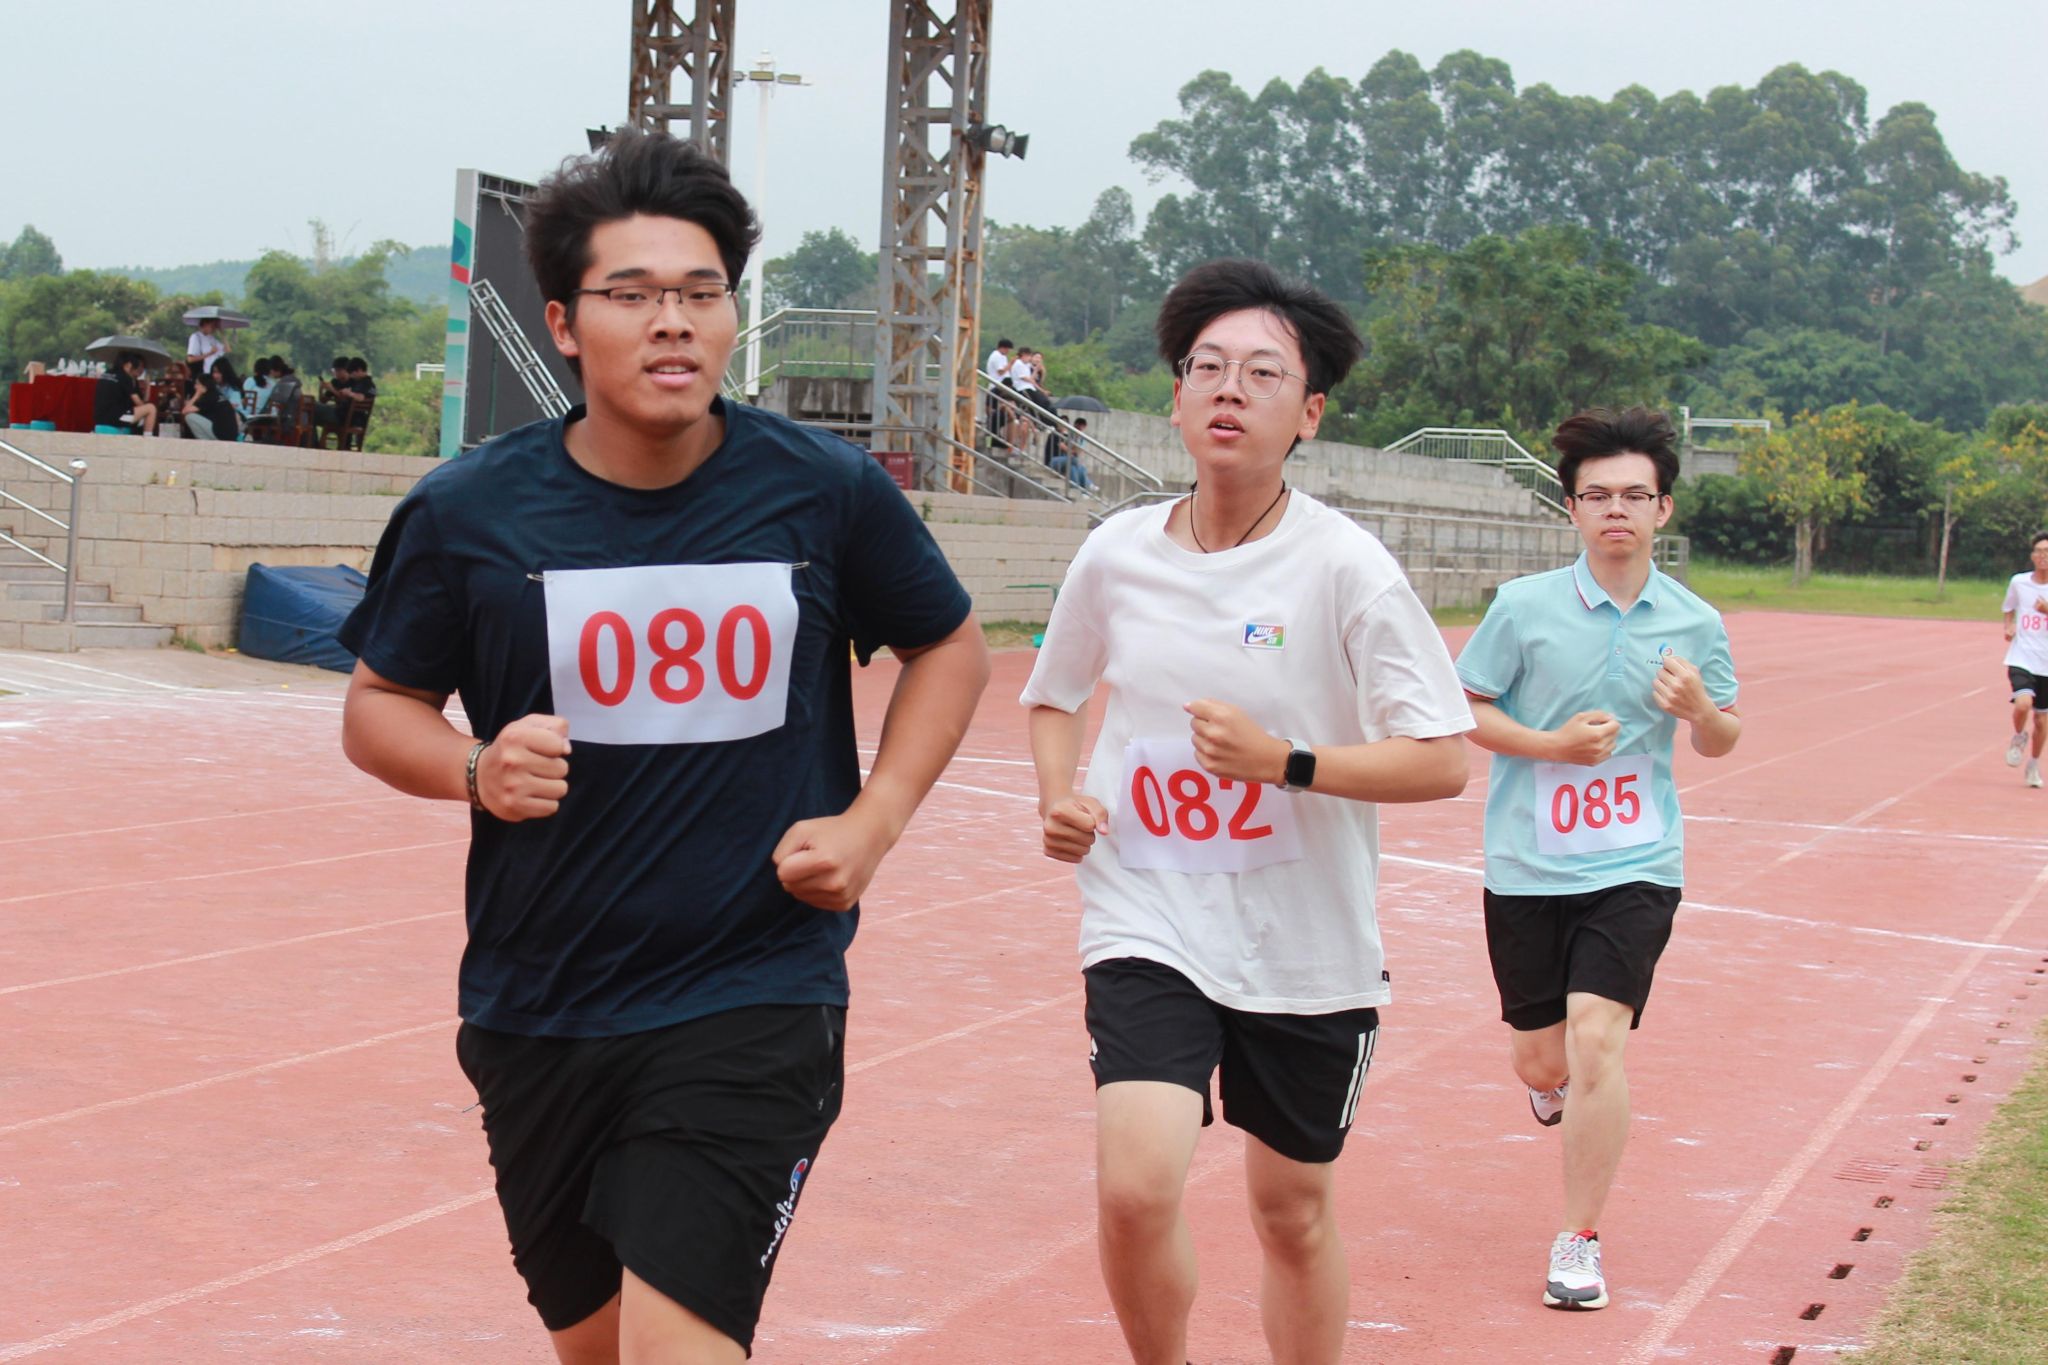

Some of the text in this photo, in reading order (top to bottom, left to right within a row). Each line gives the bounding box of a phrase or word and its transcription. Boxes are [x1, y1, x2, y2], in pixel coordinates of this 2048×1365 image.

[578, 604, 772, 706] 080
[1253, 625, 1275, 636] NIKE
[1131, 765, 1273, 841] 082
[1551, 774, 1641, 834] 085
